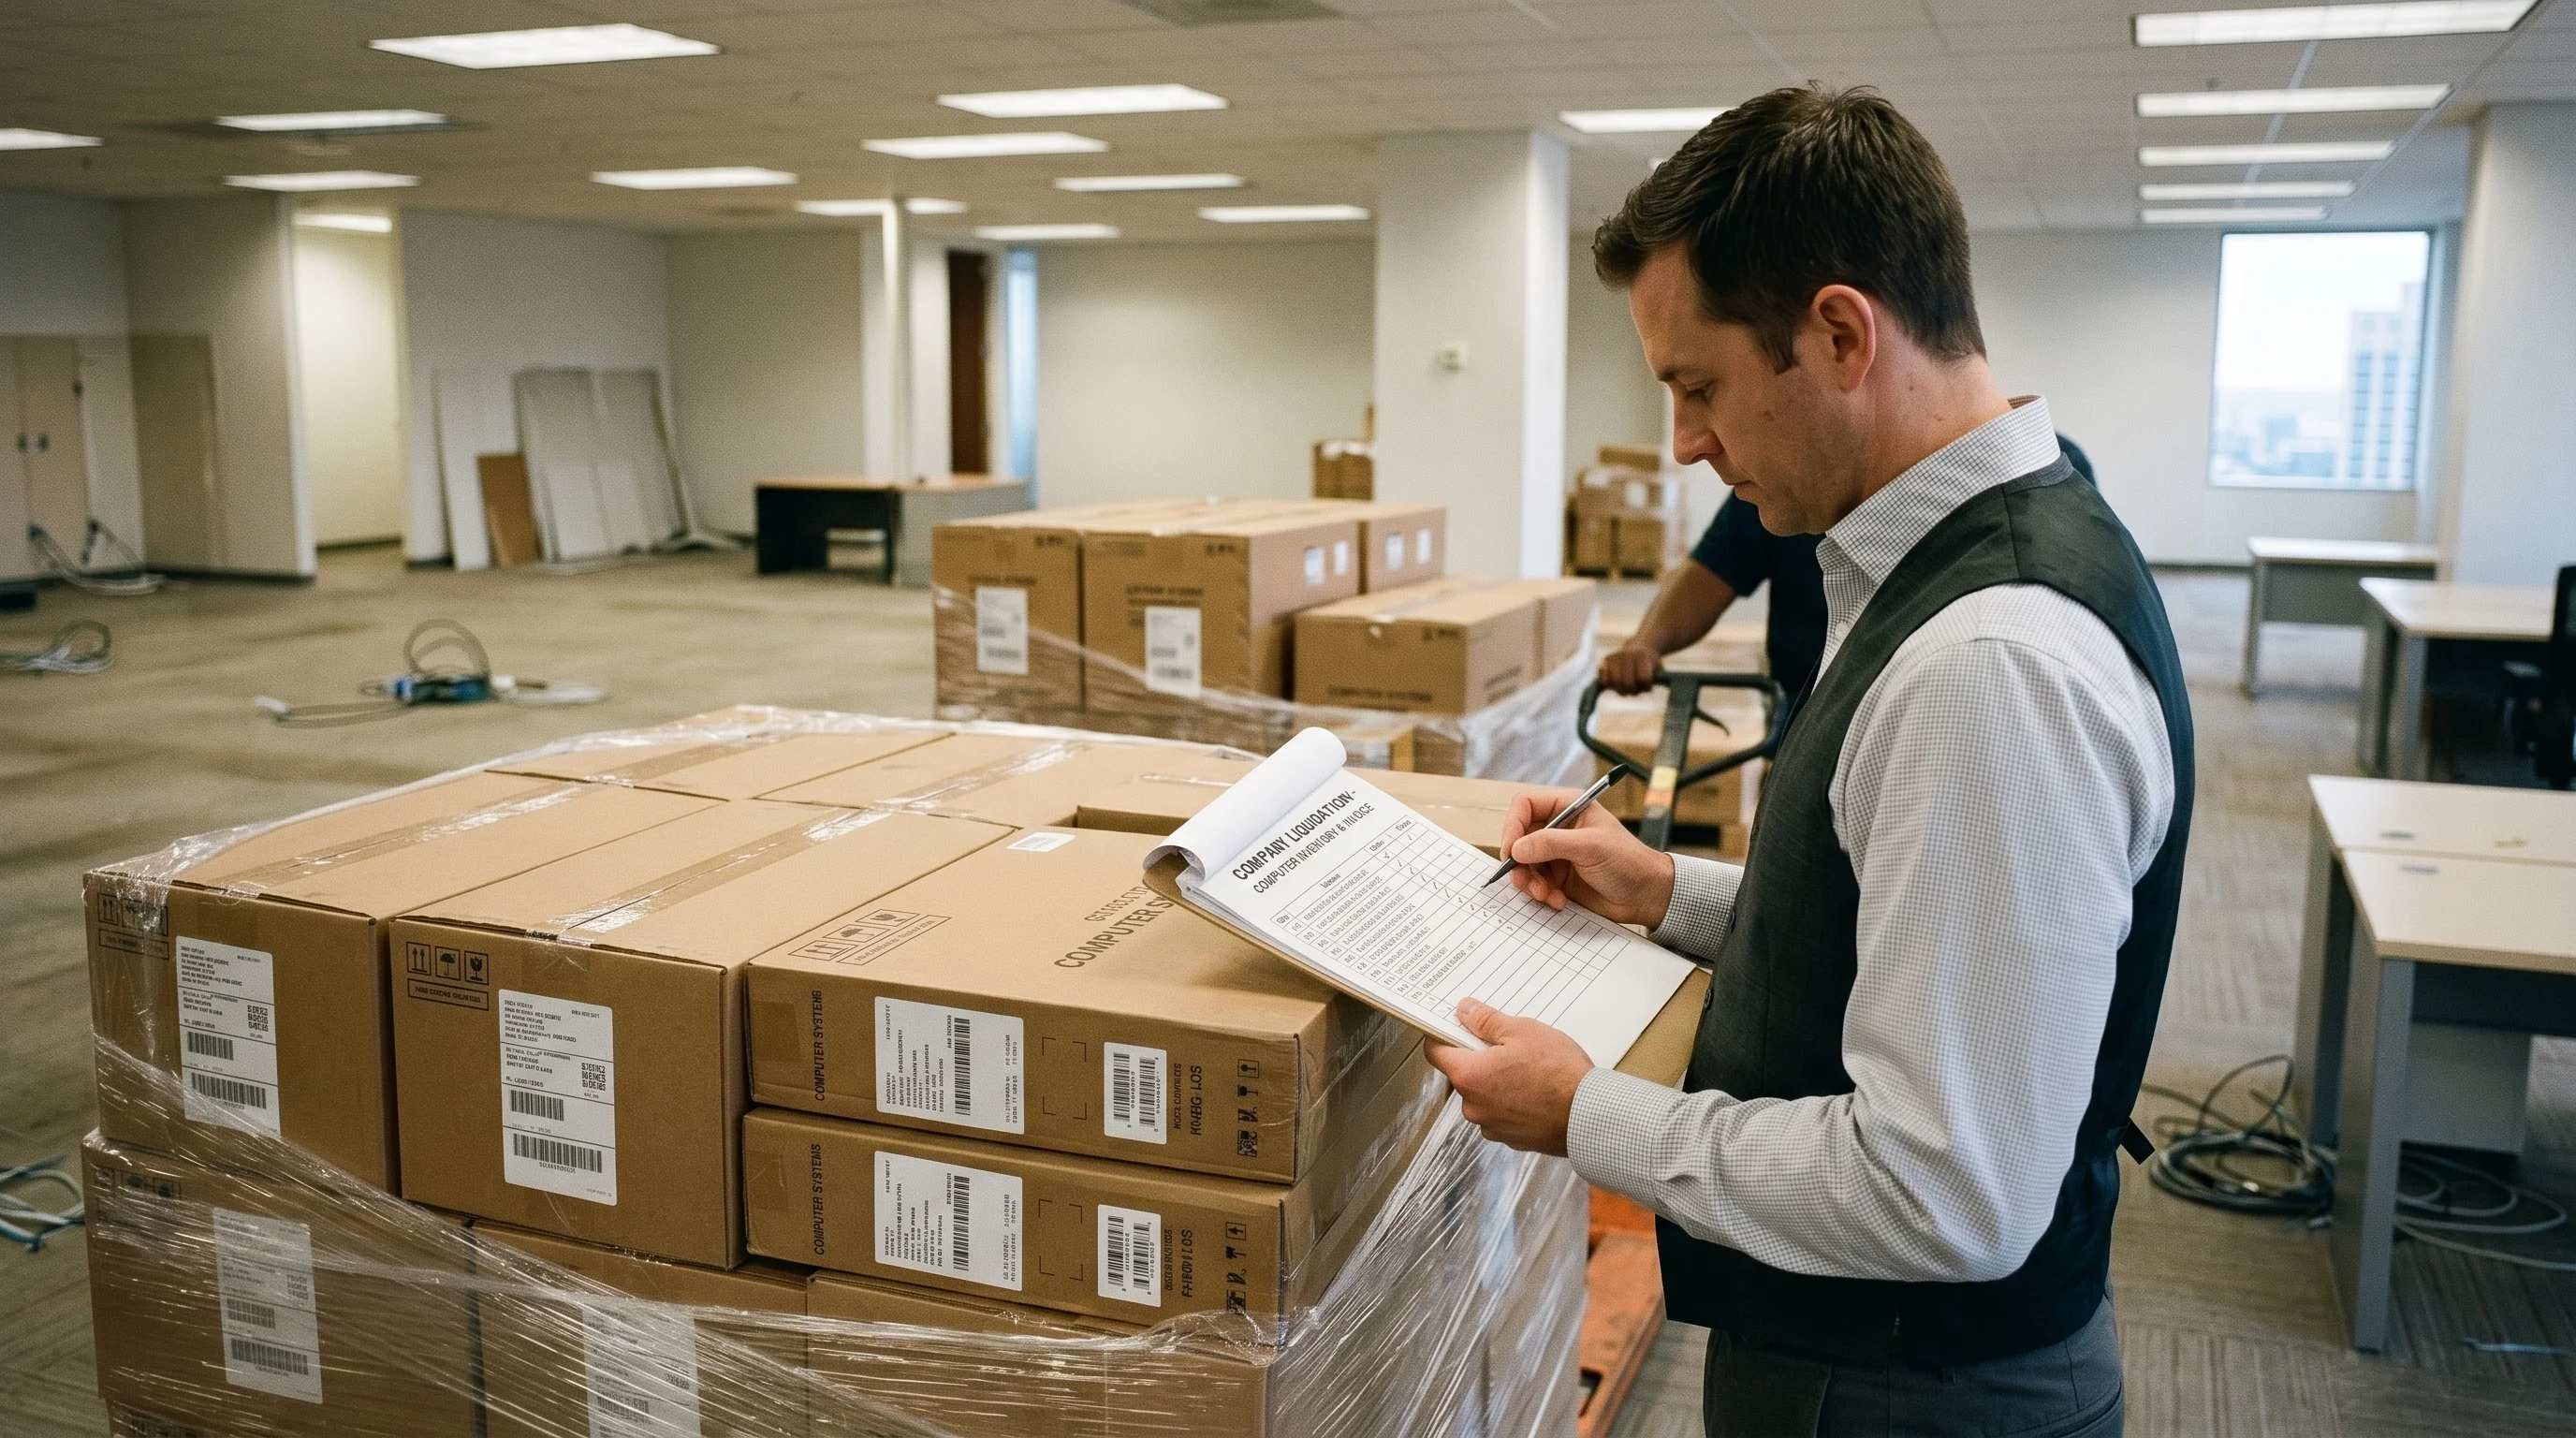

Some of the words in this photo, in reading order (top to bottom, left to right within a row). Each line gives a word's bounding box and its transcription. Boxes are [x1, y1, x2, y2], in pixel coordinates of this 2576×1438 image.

[1232, 837, 1290, 880] COMPANY
[1252, 857, 1301, 894] COMPUTER
[1054, 909, 1164, 968] COMPUTER
[813, 1041, 826, 1102] COMPUTER
[812, 1195, 826, 1255] COMPUTER
